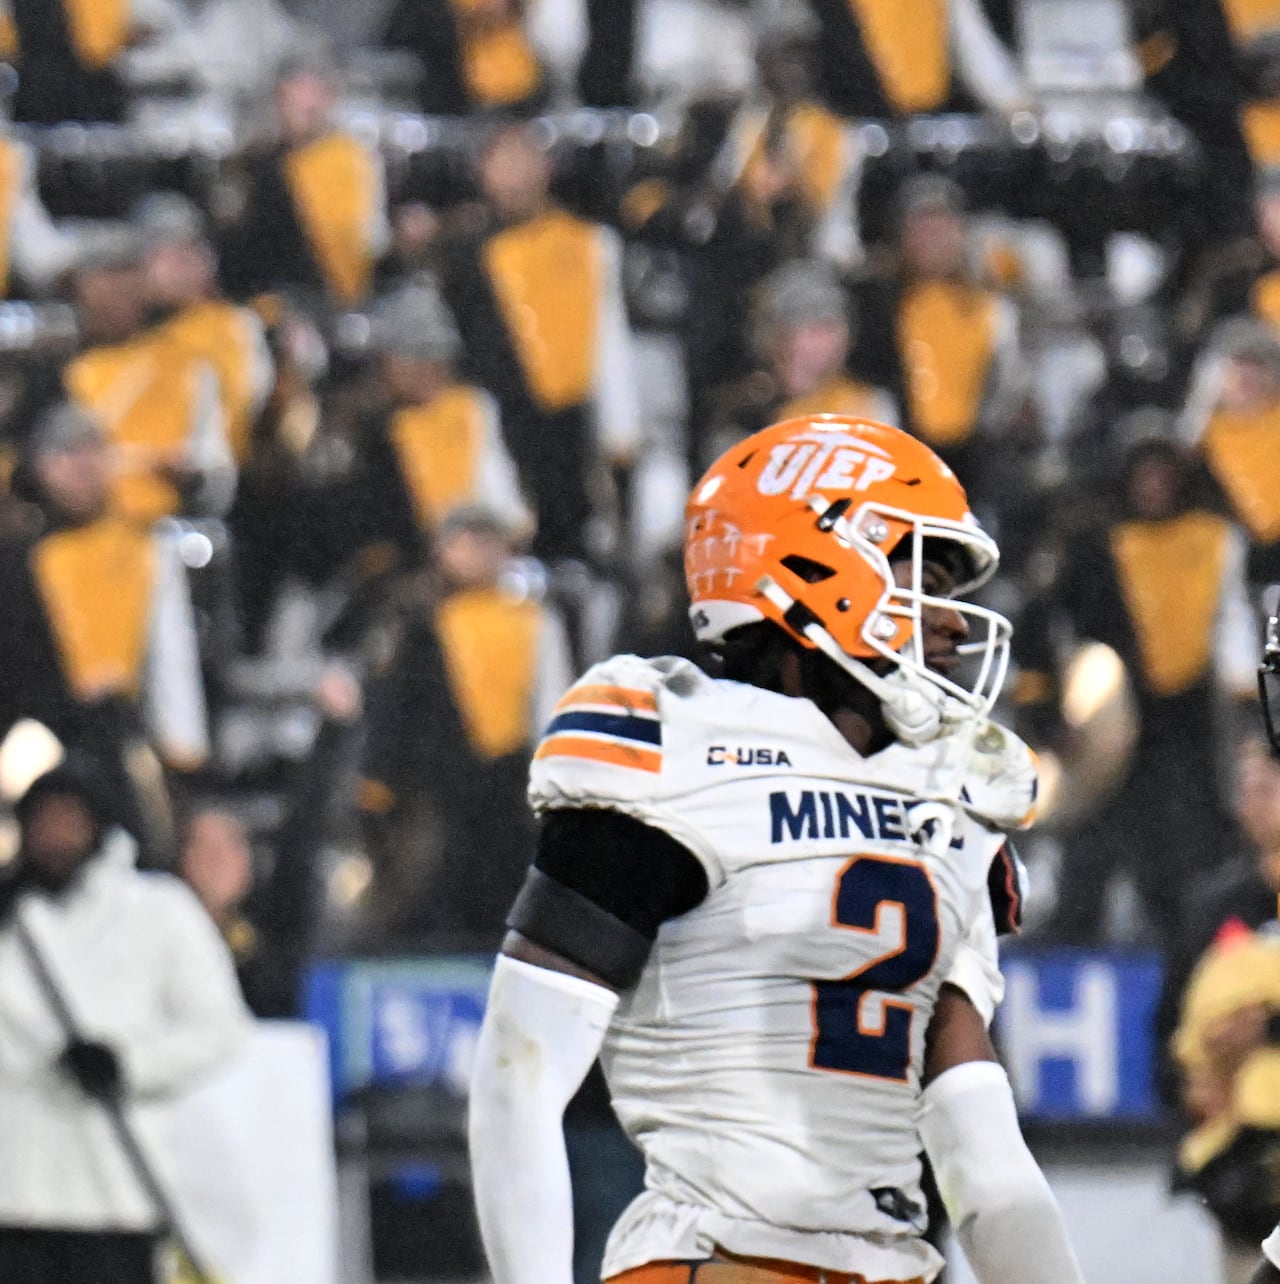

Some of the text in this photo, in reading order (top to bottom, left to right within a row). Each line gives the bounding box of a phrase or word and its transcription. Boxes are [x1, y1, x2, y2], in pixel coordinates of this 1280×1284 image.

[757, 432, 897, 500] UTEP
[768, 790, 966, 850] MINE
[807, 852, 942, 1084] 2
